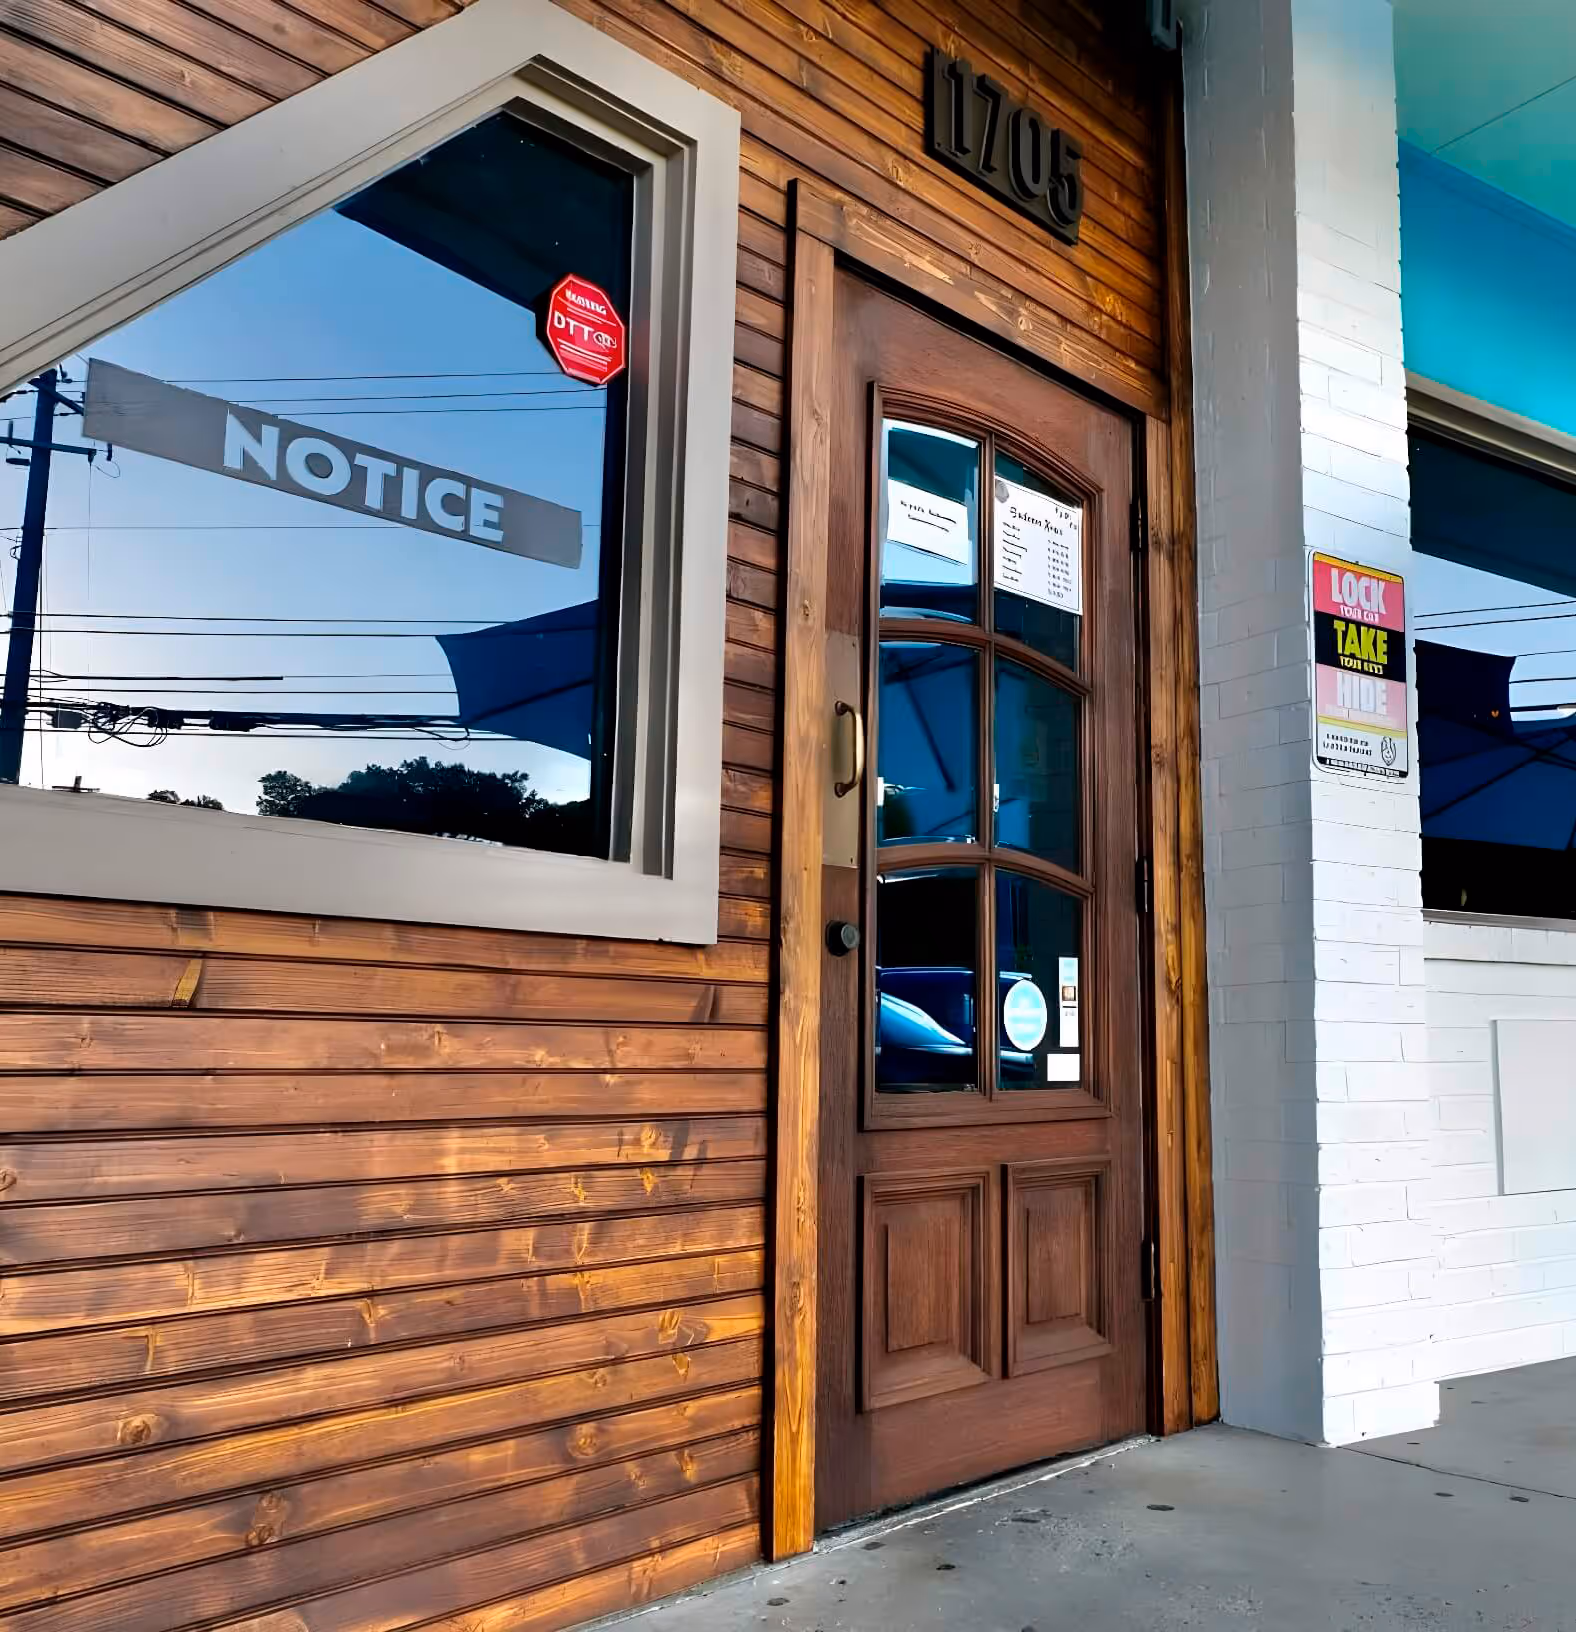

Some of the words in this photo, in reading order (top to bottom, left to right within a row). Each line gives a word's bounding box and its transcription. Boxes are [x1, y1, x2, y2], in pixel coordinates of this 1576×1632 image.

[943, 58, 1080, 228] 1705
[223, 408, 504, 542] NOTICE
[1331, 567, 1387, 615] LOCK
[1333, 619, 1388, 665] TAKE
[1336, 671, 1387, 715] HIDE
